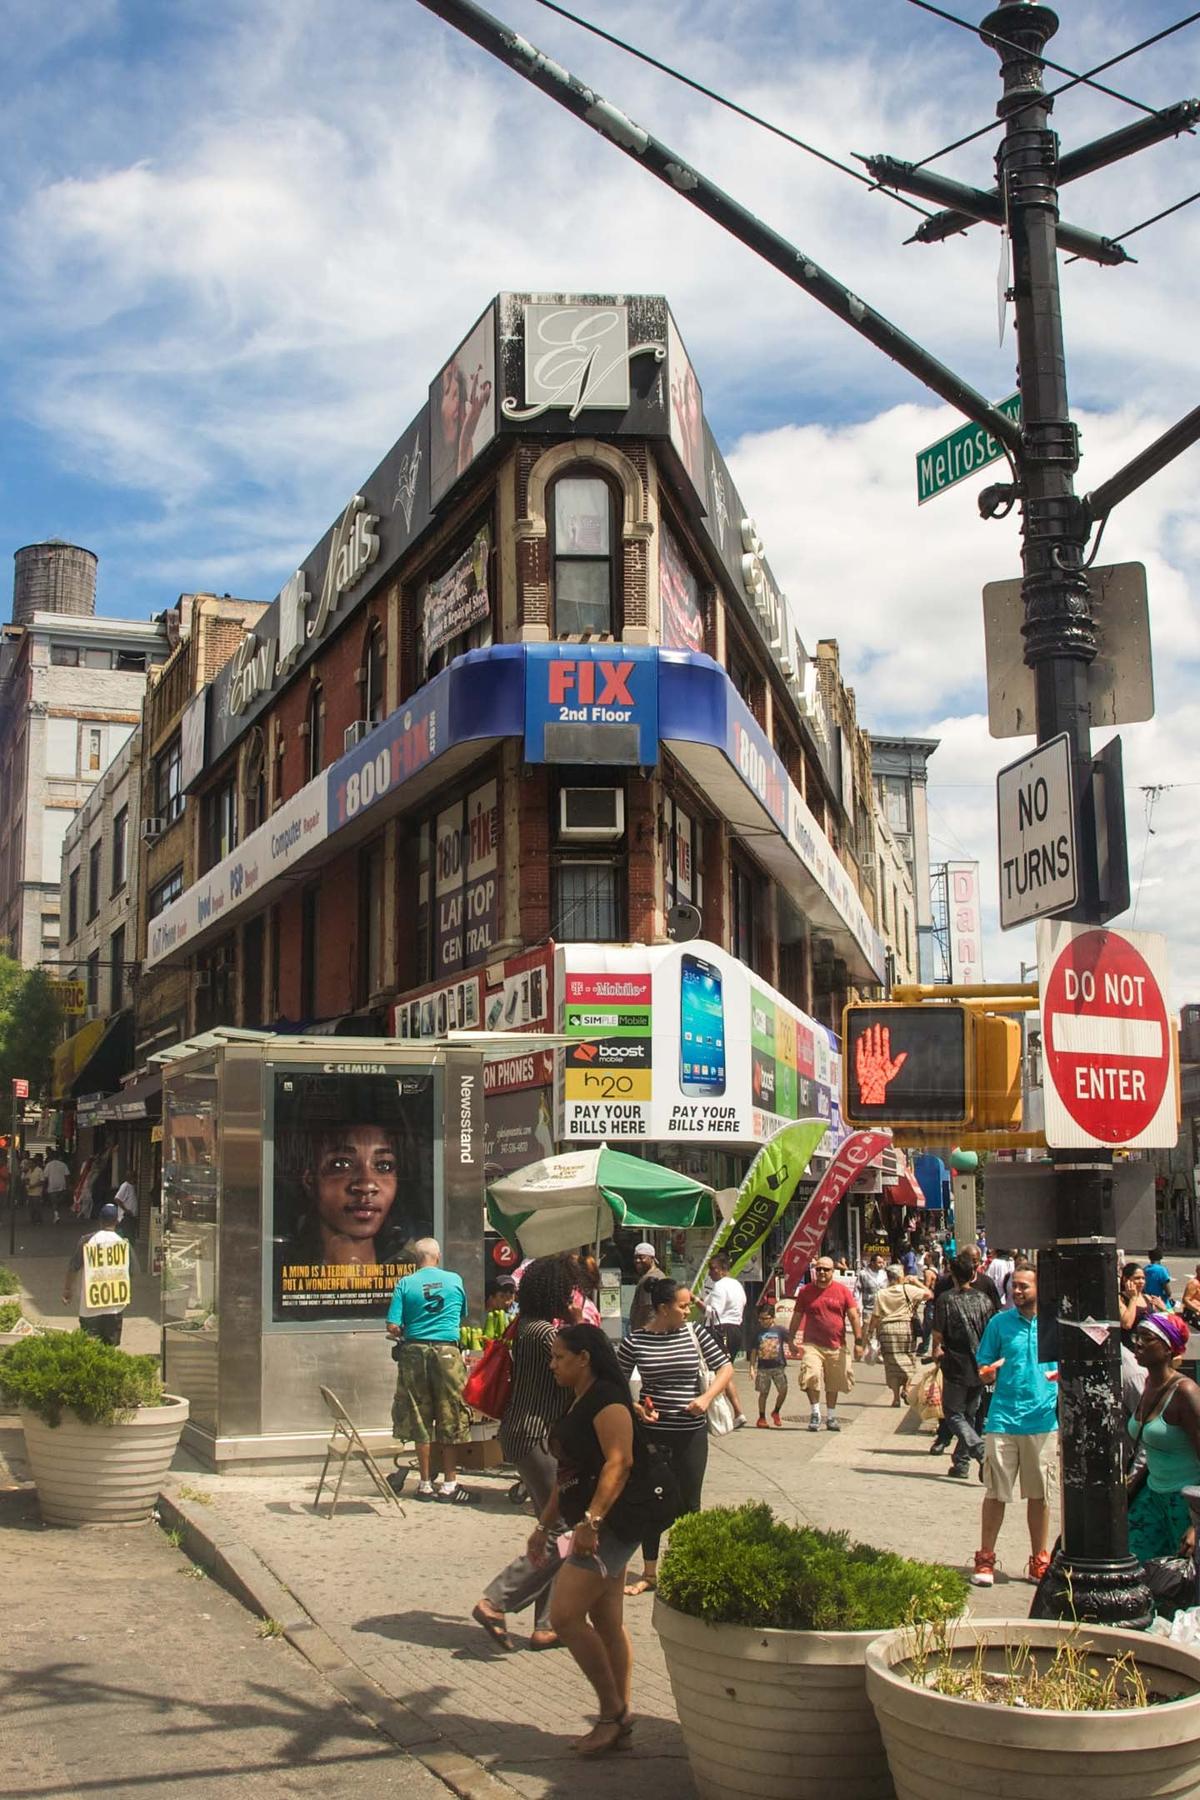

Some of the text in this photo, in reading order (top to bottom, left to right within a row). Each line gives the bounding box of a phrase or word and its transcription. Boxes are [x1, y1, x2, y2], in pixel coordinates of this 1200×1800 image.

[921, 430, 997, 496] Melrose
[306, 495, 381, 638] Nails
[548, 660, 636, 705] FIX
[559, 707, 632, 721] 2nd Floor
[1018, 776, 1048, 831] NO
[1003, 835, 1070, 899] TURNS
[1064, 968, 1146, 1007] DO NOT
[583, 1015, 648, 1026] SIMPLE Mobile
[599, 1044, 645, 1058] boost
[337, 1064, 386, 1074] CEMUSA
[498, 1057, 534, 1087] PHONES
[1075, 1067, 1146, 1101] ENTER
[460, 1075, 475, 1164] Newsstand
[574, 1105, 641, 1118] PAY YOUR
[672, 1106, 736, 1119] PAY YOUR
[570, 1121, 646, 1134] BILLS HERE
[668, 1119, 704, 1131] BILLS
[706, 1120, 740, 1132] HERE
[85, 1243, 128, 1268] WE BUY
[500, 1246, 511, 1261] 2
[282, 1265, 288, 1278] A
[311, 1265, 320, 1277] IS
[320, 1265, 326, 1277] A
[386, 1264, 395, 1276] TO
[396, 1264, 416, 1276] WAST
[298, 1278, 304, 1290] A
[374, 1277, 384, 1289] TO
[89, 1281, 128, 1306] GOLD
[422, 1282, 445, 1313] 5
